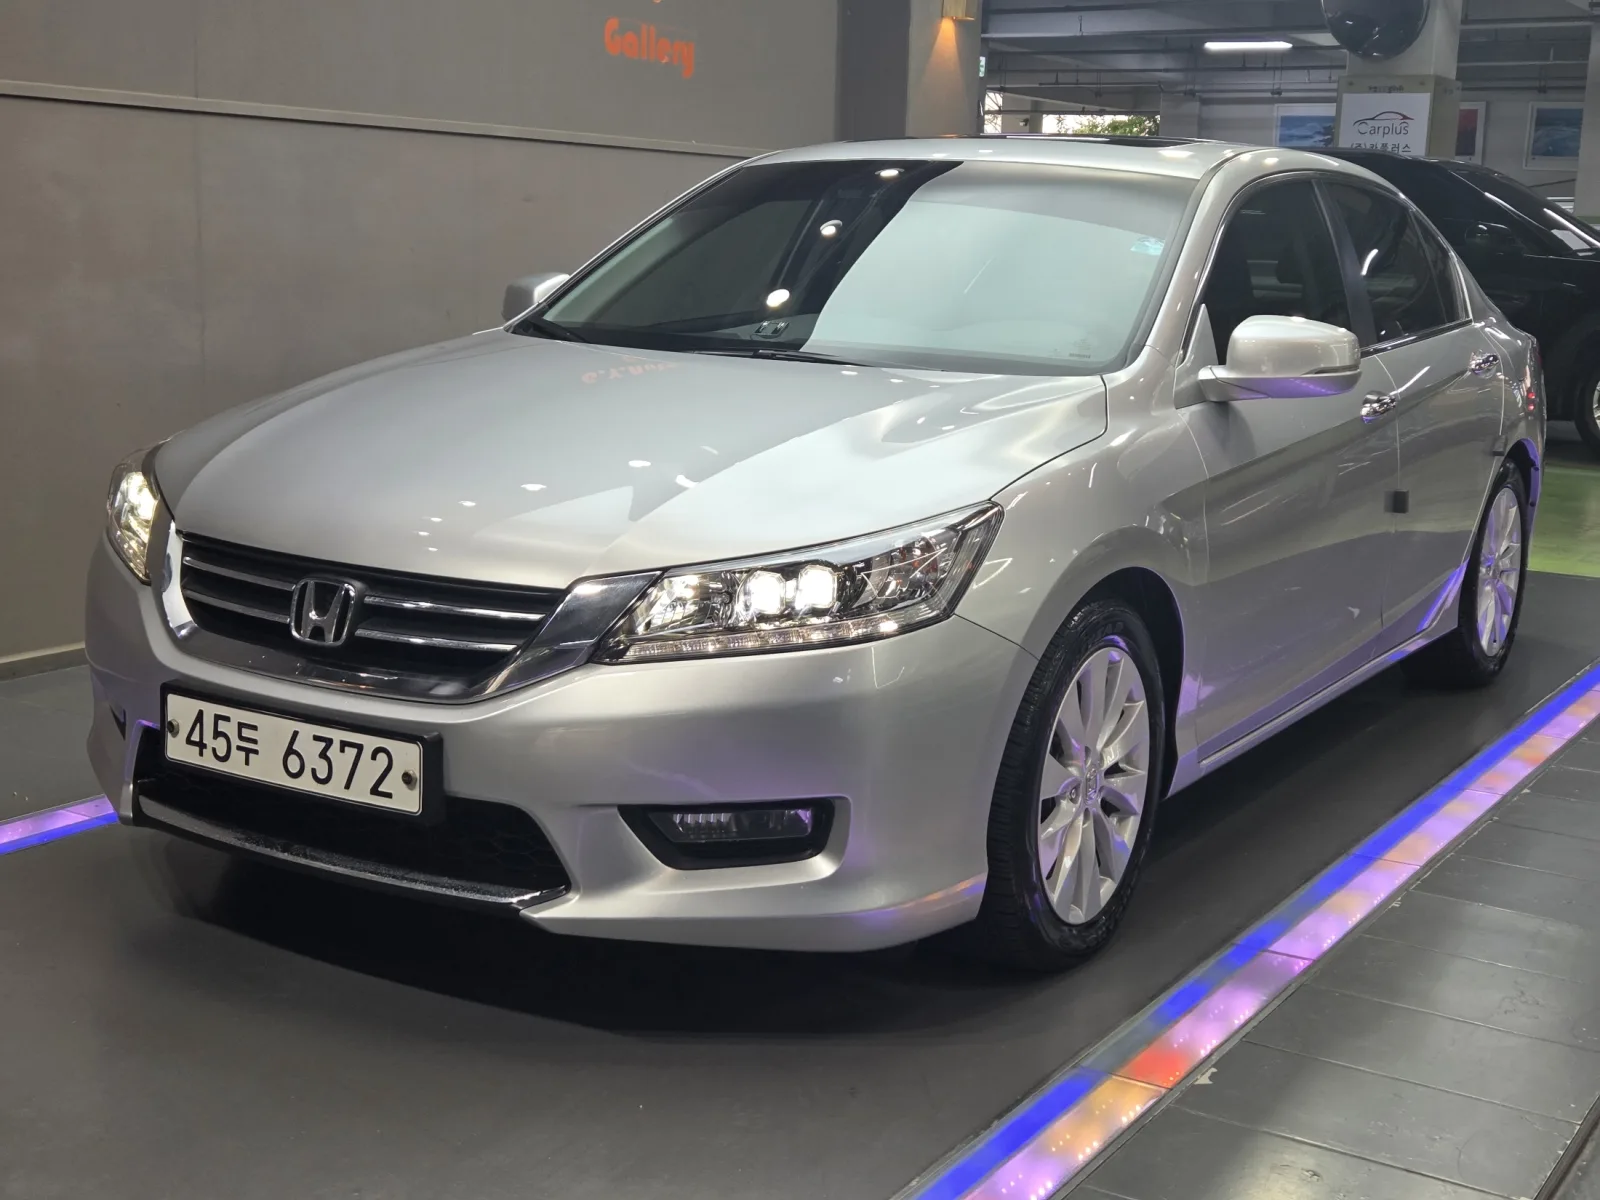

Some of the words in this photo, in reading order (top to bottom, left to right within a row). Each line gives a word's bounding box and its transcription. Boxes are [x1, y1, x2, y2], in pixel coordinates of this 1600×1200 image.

[604, 17, 695, 79] Gallery
[1357, 121, 1410, 138] Carplus
[185, 708, 260, 766] 45두
[282, 729, 395, 799] 6372
